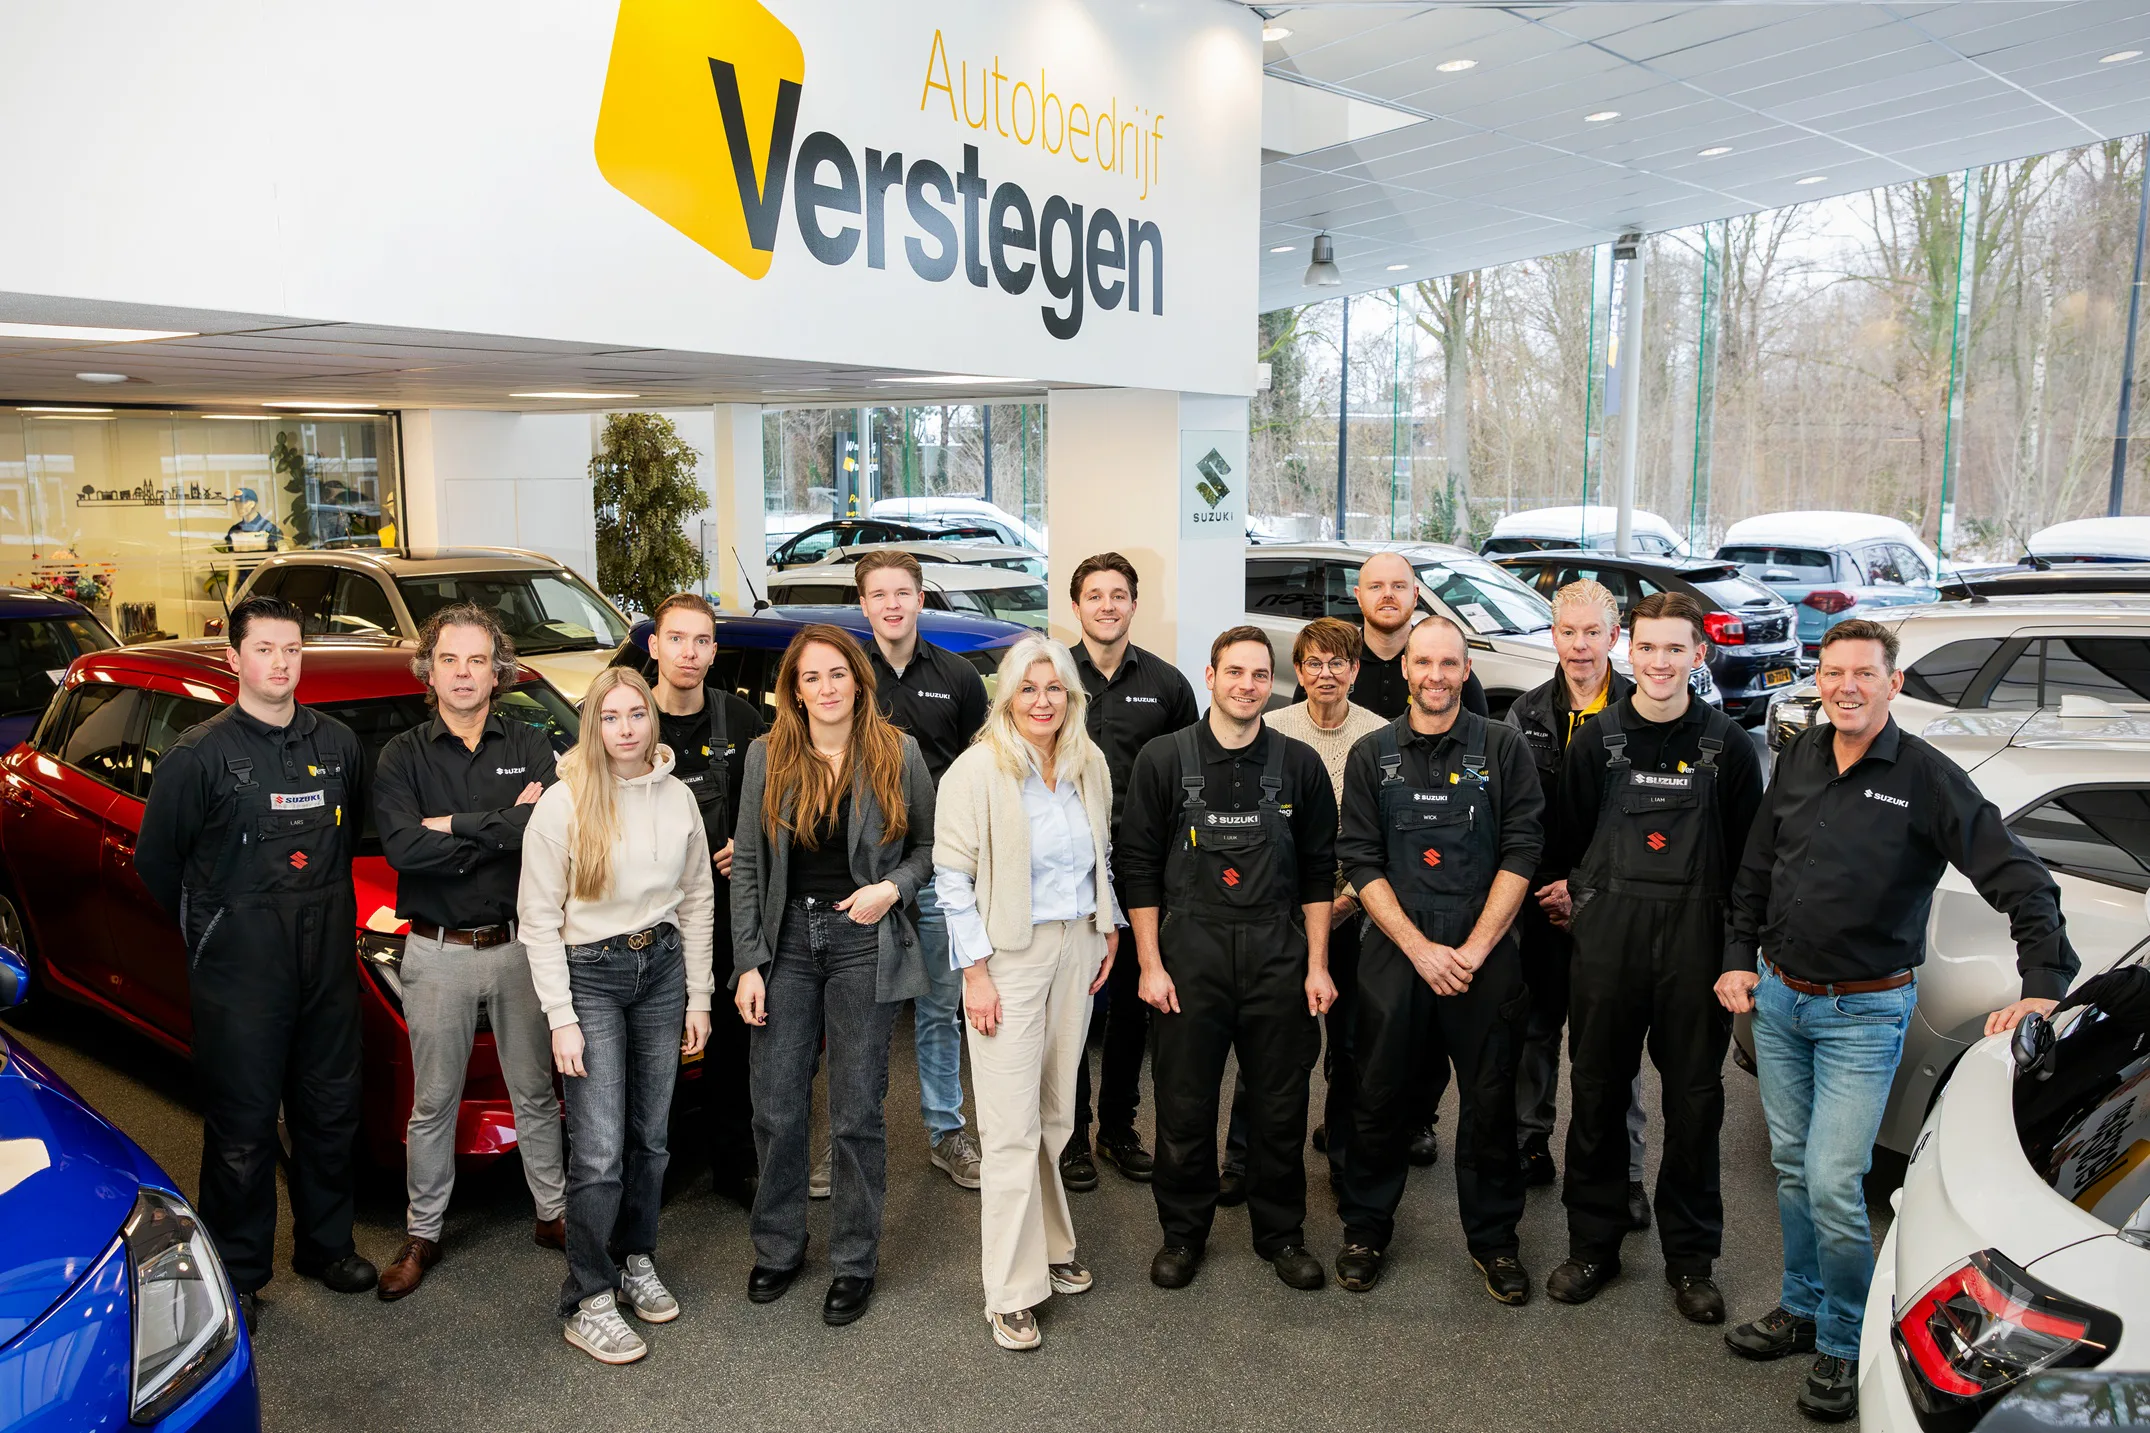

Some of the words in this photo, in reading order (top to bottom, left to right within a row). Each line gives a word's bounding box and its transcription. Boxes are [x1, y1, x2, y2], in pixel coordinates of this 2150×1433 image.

[920, 29, 1164, 200] Autobedrijf
[708, 56, 1164, 340] Verstegen
[1193, 512, 1233, 522] SUZUKI
[1645, 776, 1688, 786] SUZUKI
[286, 794, 320, 803] SUZUKI
[1873, 792, 1909, 808] SUZUKI
[1219, 815, 1258, 824] SUZUKI
